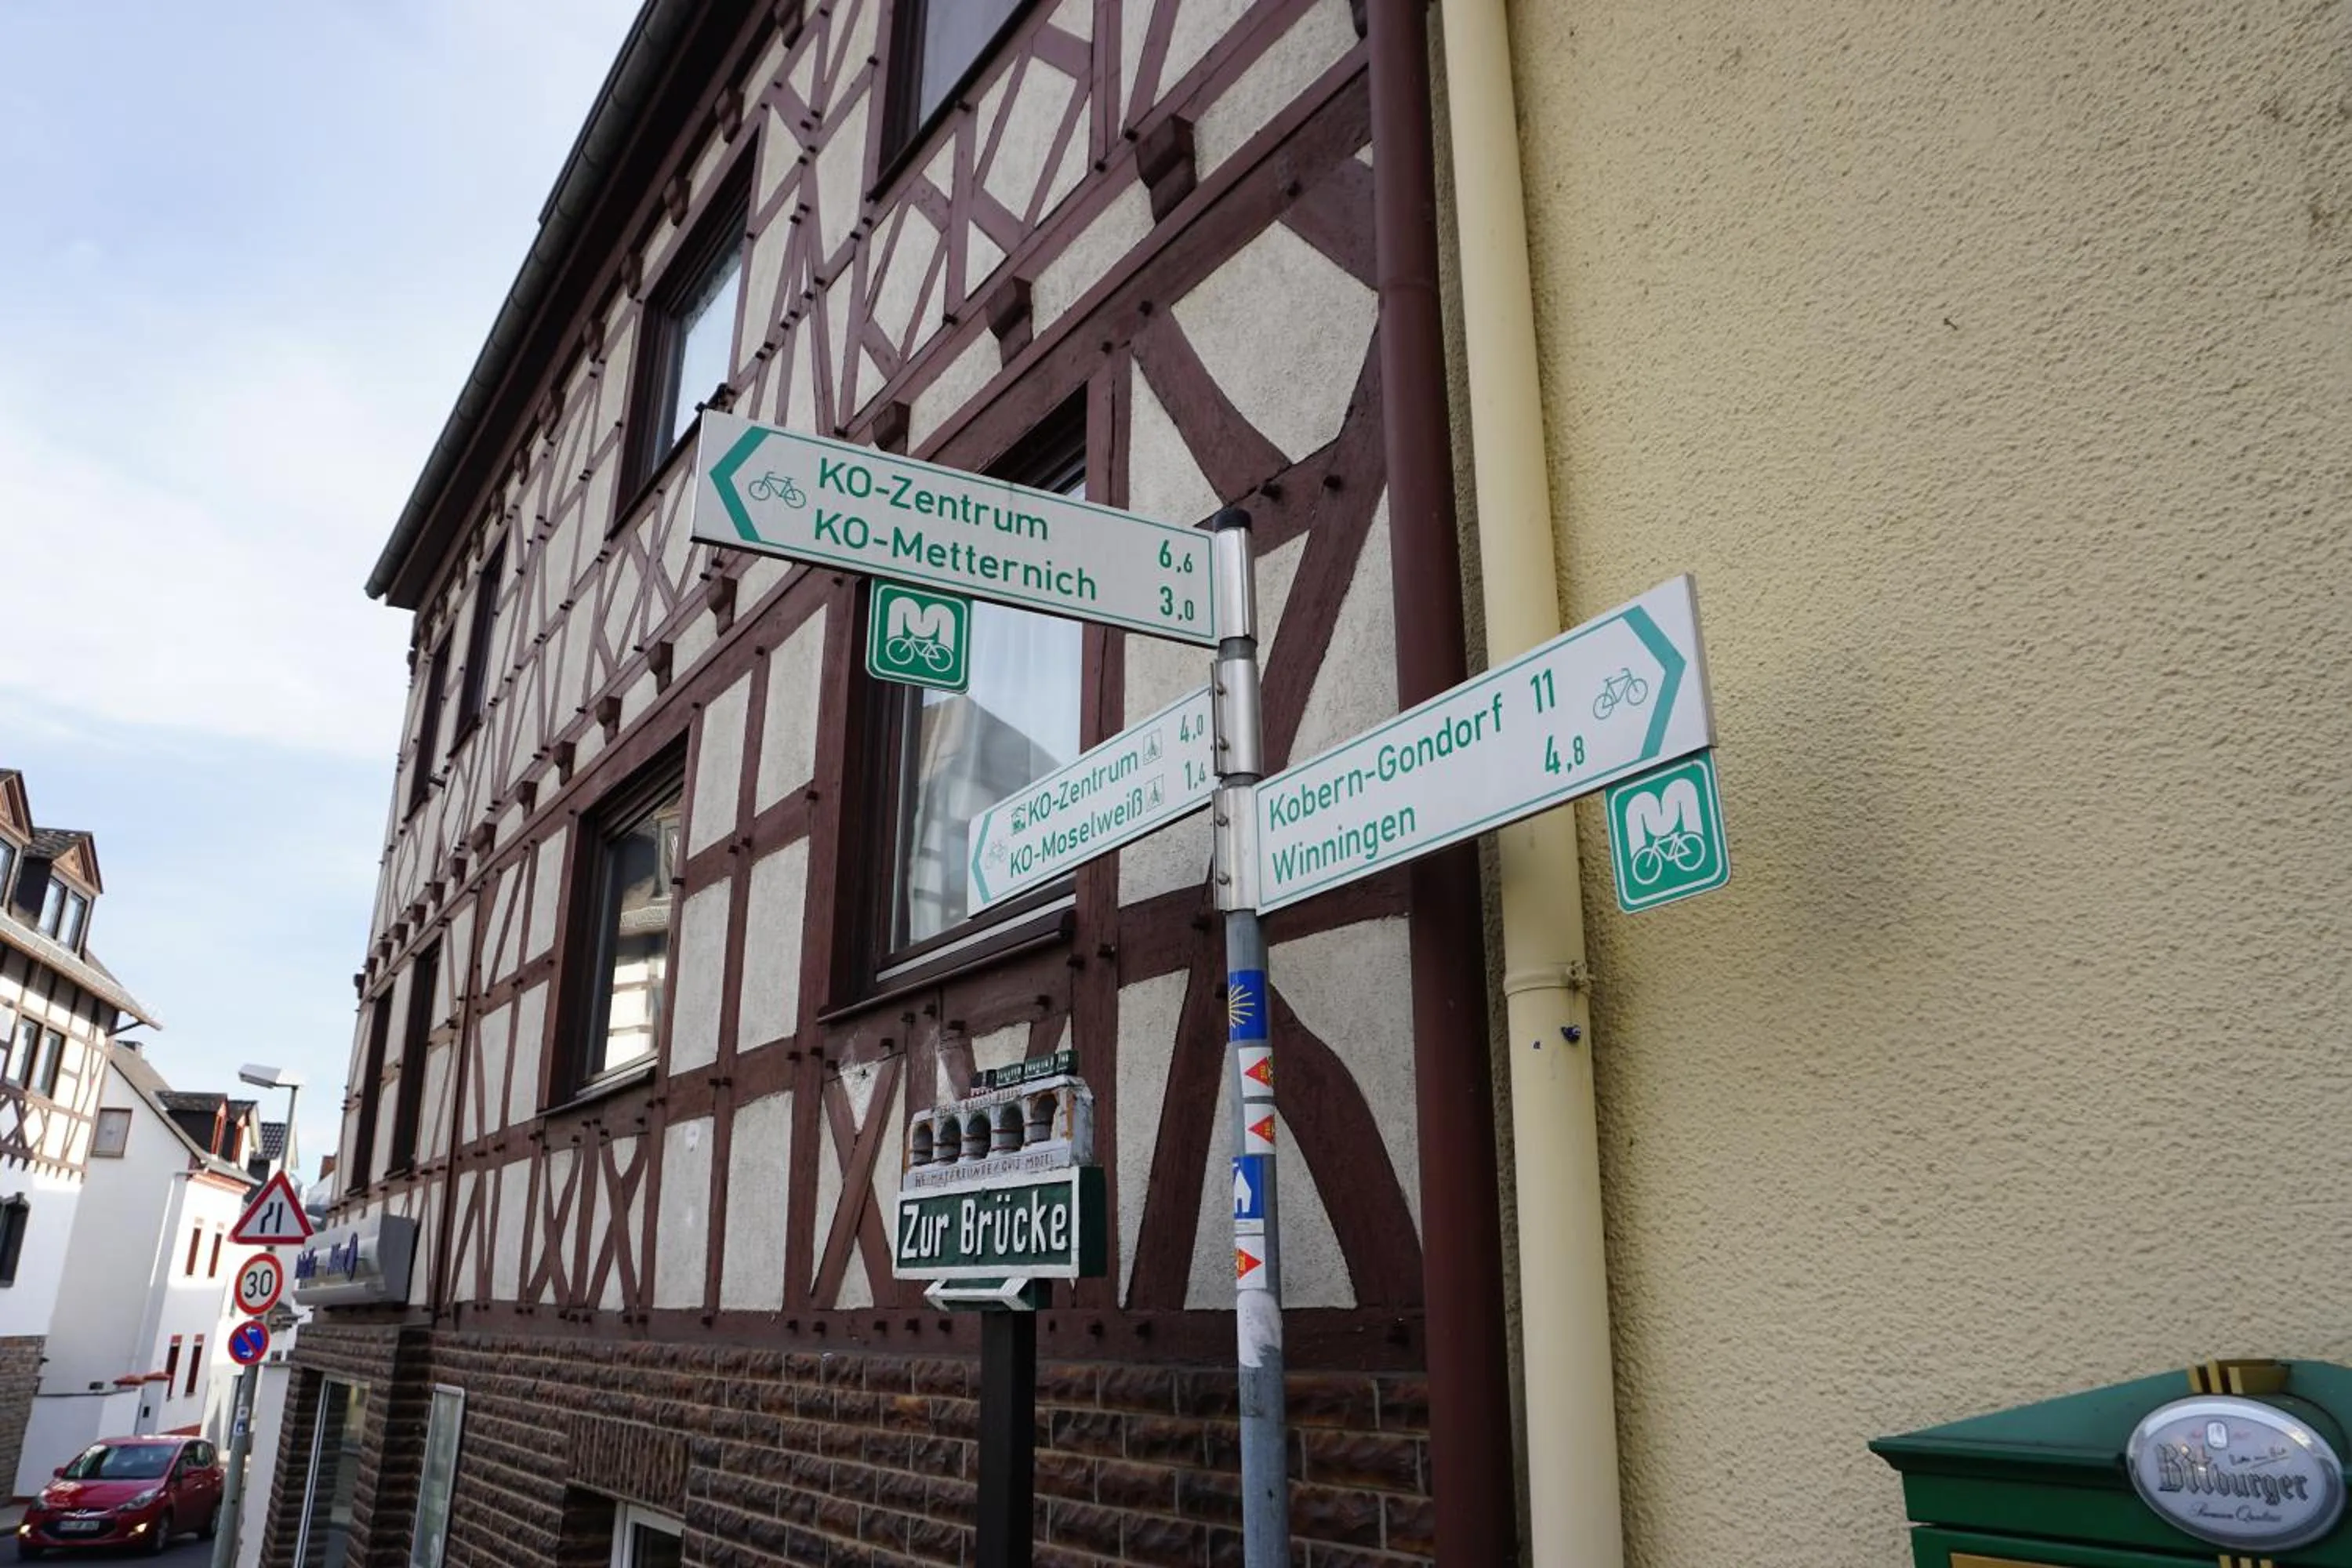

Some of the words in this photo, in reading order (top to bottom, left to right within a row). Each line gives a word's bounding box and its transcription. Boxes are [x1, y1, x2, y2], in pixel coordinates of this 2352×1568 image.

[819, 457, 1049, 543] KO-Zentrum
[814, 509, 1097, 601] KO-Metternich
[1159, 587, 1195, 622] 3,0
[1028, 750, 1138, 828] KO-Zentrum
[1269, 692, 1503, 832] Kobern-Gondorf
[1530, 669, 1555, 713] 11
[1010, 787, 1143, 878] KO-Moselweiß
[1272, 806, 1417, 885] Winningen
[1544, 735, 1586, 776] 4,8
[901, 1203, 949, 1259] Zur
[960, 1189, 1069, 1256] Brücke
[244, 1269, 274, 1299] 30
[2157, 1443, 2309, 1504] Bitburger
